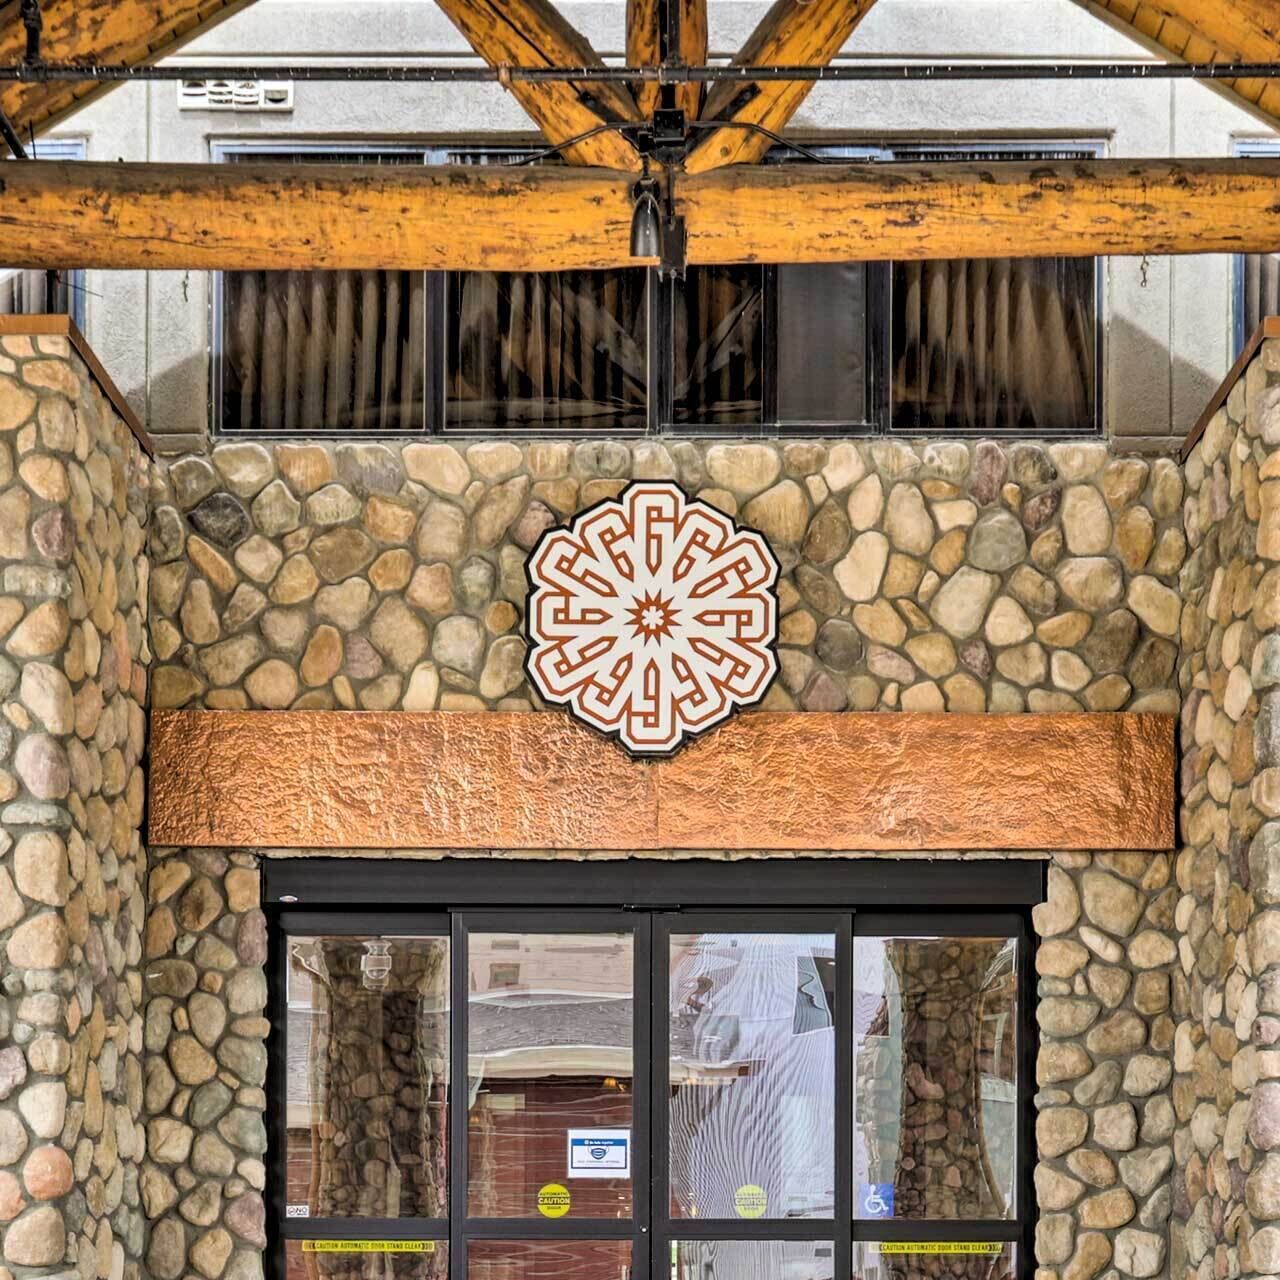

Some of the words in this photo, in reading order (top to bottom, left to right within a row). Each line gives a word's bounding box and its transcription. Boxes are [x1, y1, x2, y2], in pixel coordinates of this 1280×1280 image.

[316, 1242, 338, 1250] CAUTION
[340, 1242, 369, 1250] AUTOMATIC
[883, 1243, 905, 1251] CAUTION
[907, 1243, 936, 1251] AUTOMATIC
[953, 1243, 970, 1251] STAND
